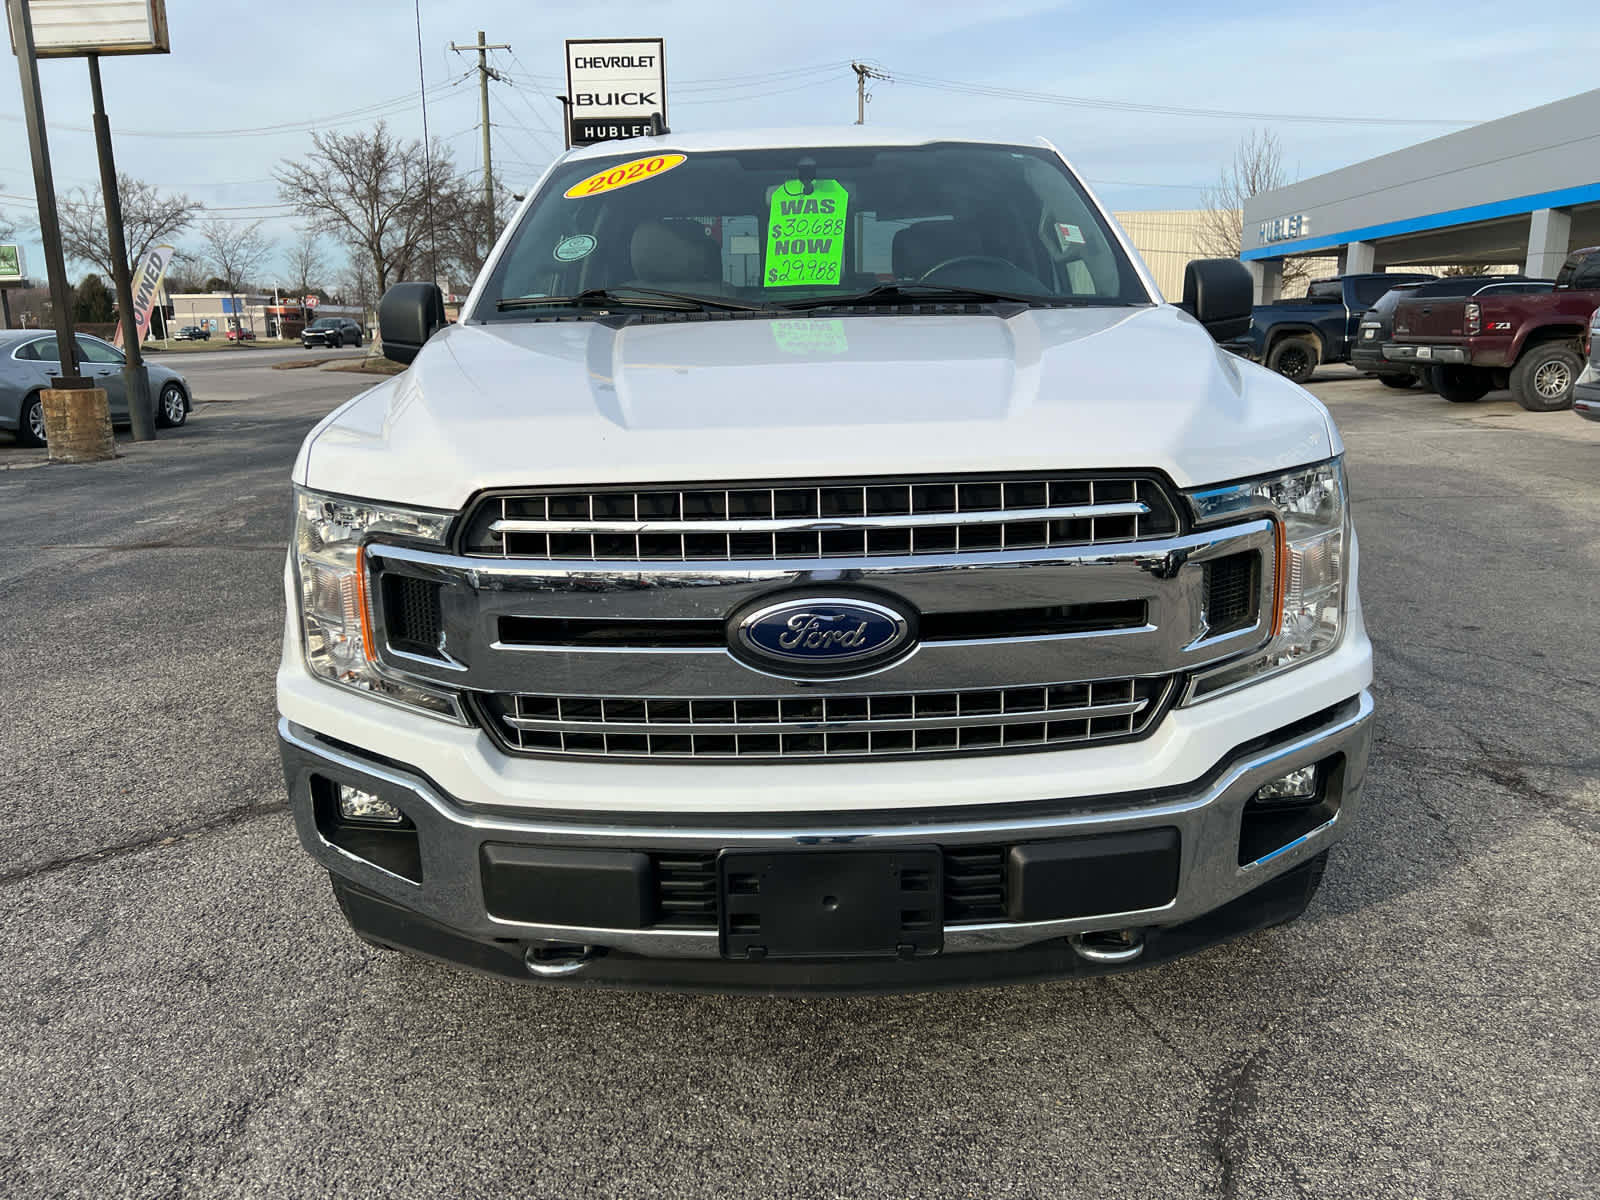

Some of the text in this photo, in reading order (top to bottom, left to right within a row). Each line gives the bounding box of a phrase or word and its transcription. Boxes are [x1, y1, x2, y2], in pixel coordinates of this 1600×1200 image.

[575, 56, 655, 69] CHEVROLET
[576, 92, 656, 106] BUICK
[587, 158, 664, 194] 2020
[781, 199, 835, 216] WAS
[775, 239, 833, 256] NOW
[779, 613, 867, 649] Ford
